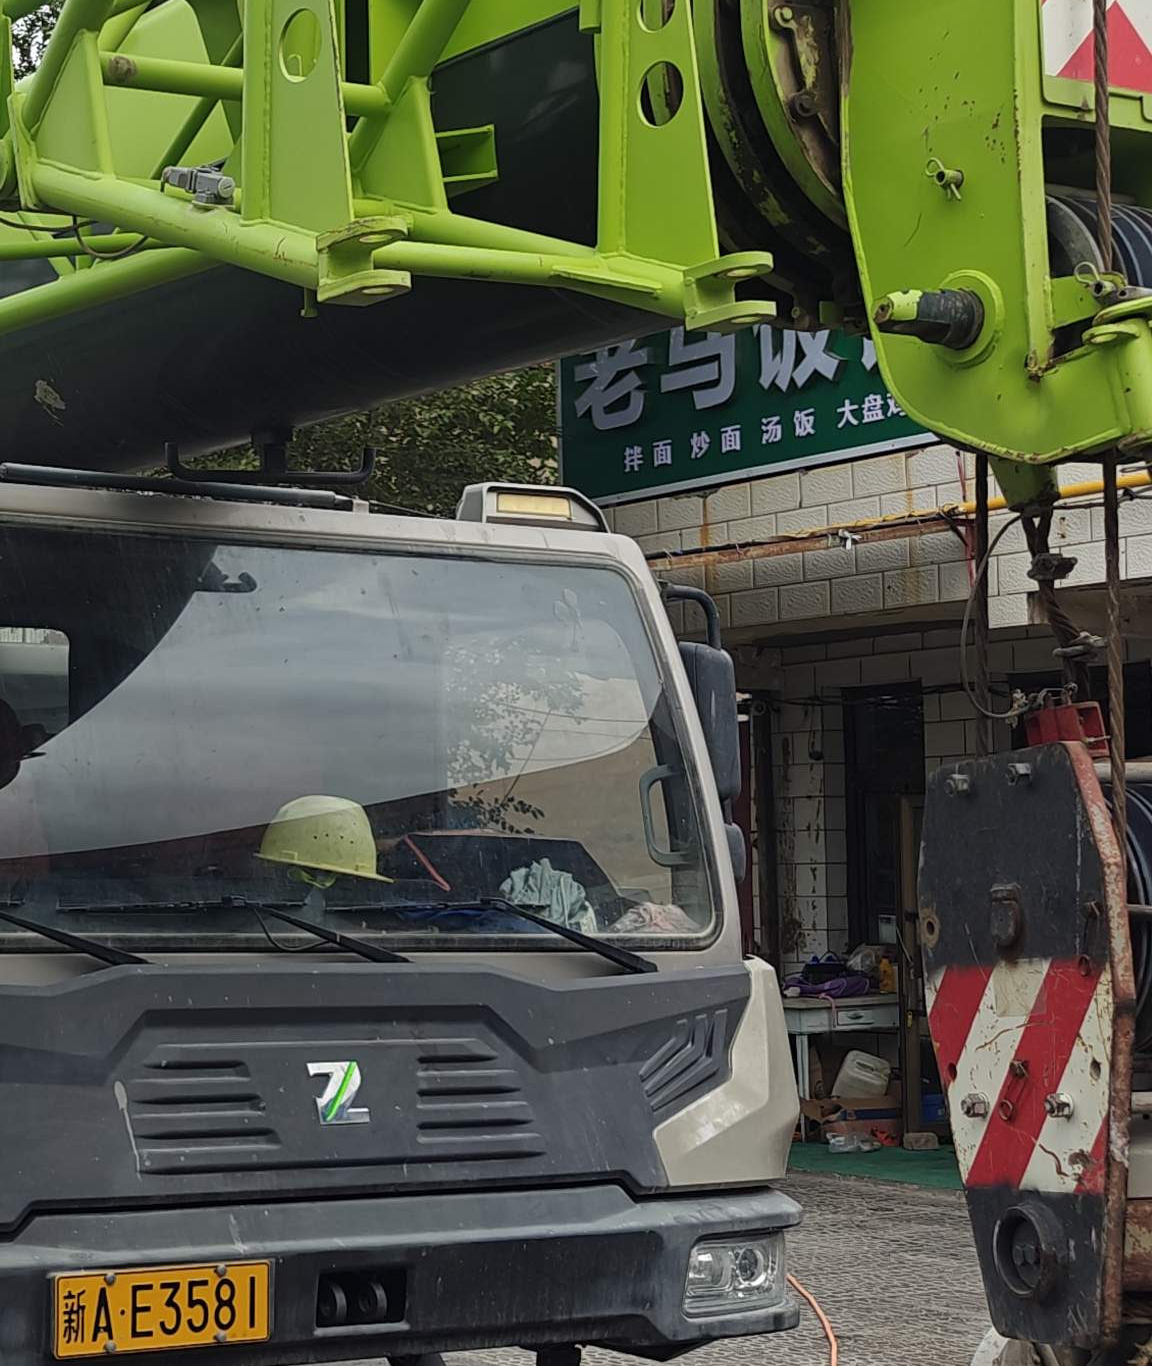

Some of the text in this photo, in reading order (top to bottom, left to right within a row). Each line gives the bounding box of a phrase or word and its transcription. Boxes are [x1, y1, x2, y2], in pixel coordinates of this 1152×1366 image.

[574, 325, 877, 430] 老马饭
[624, 439, 672, 472] 拌面
[689, 424, 741, 460] 炒面
[760, 408, 816, 445] 汤饭
